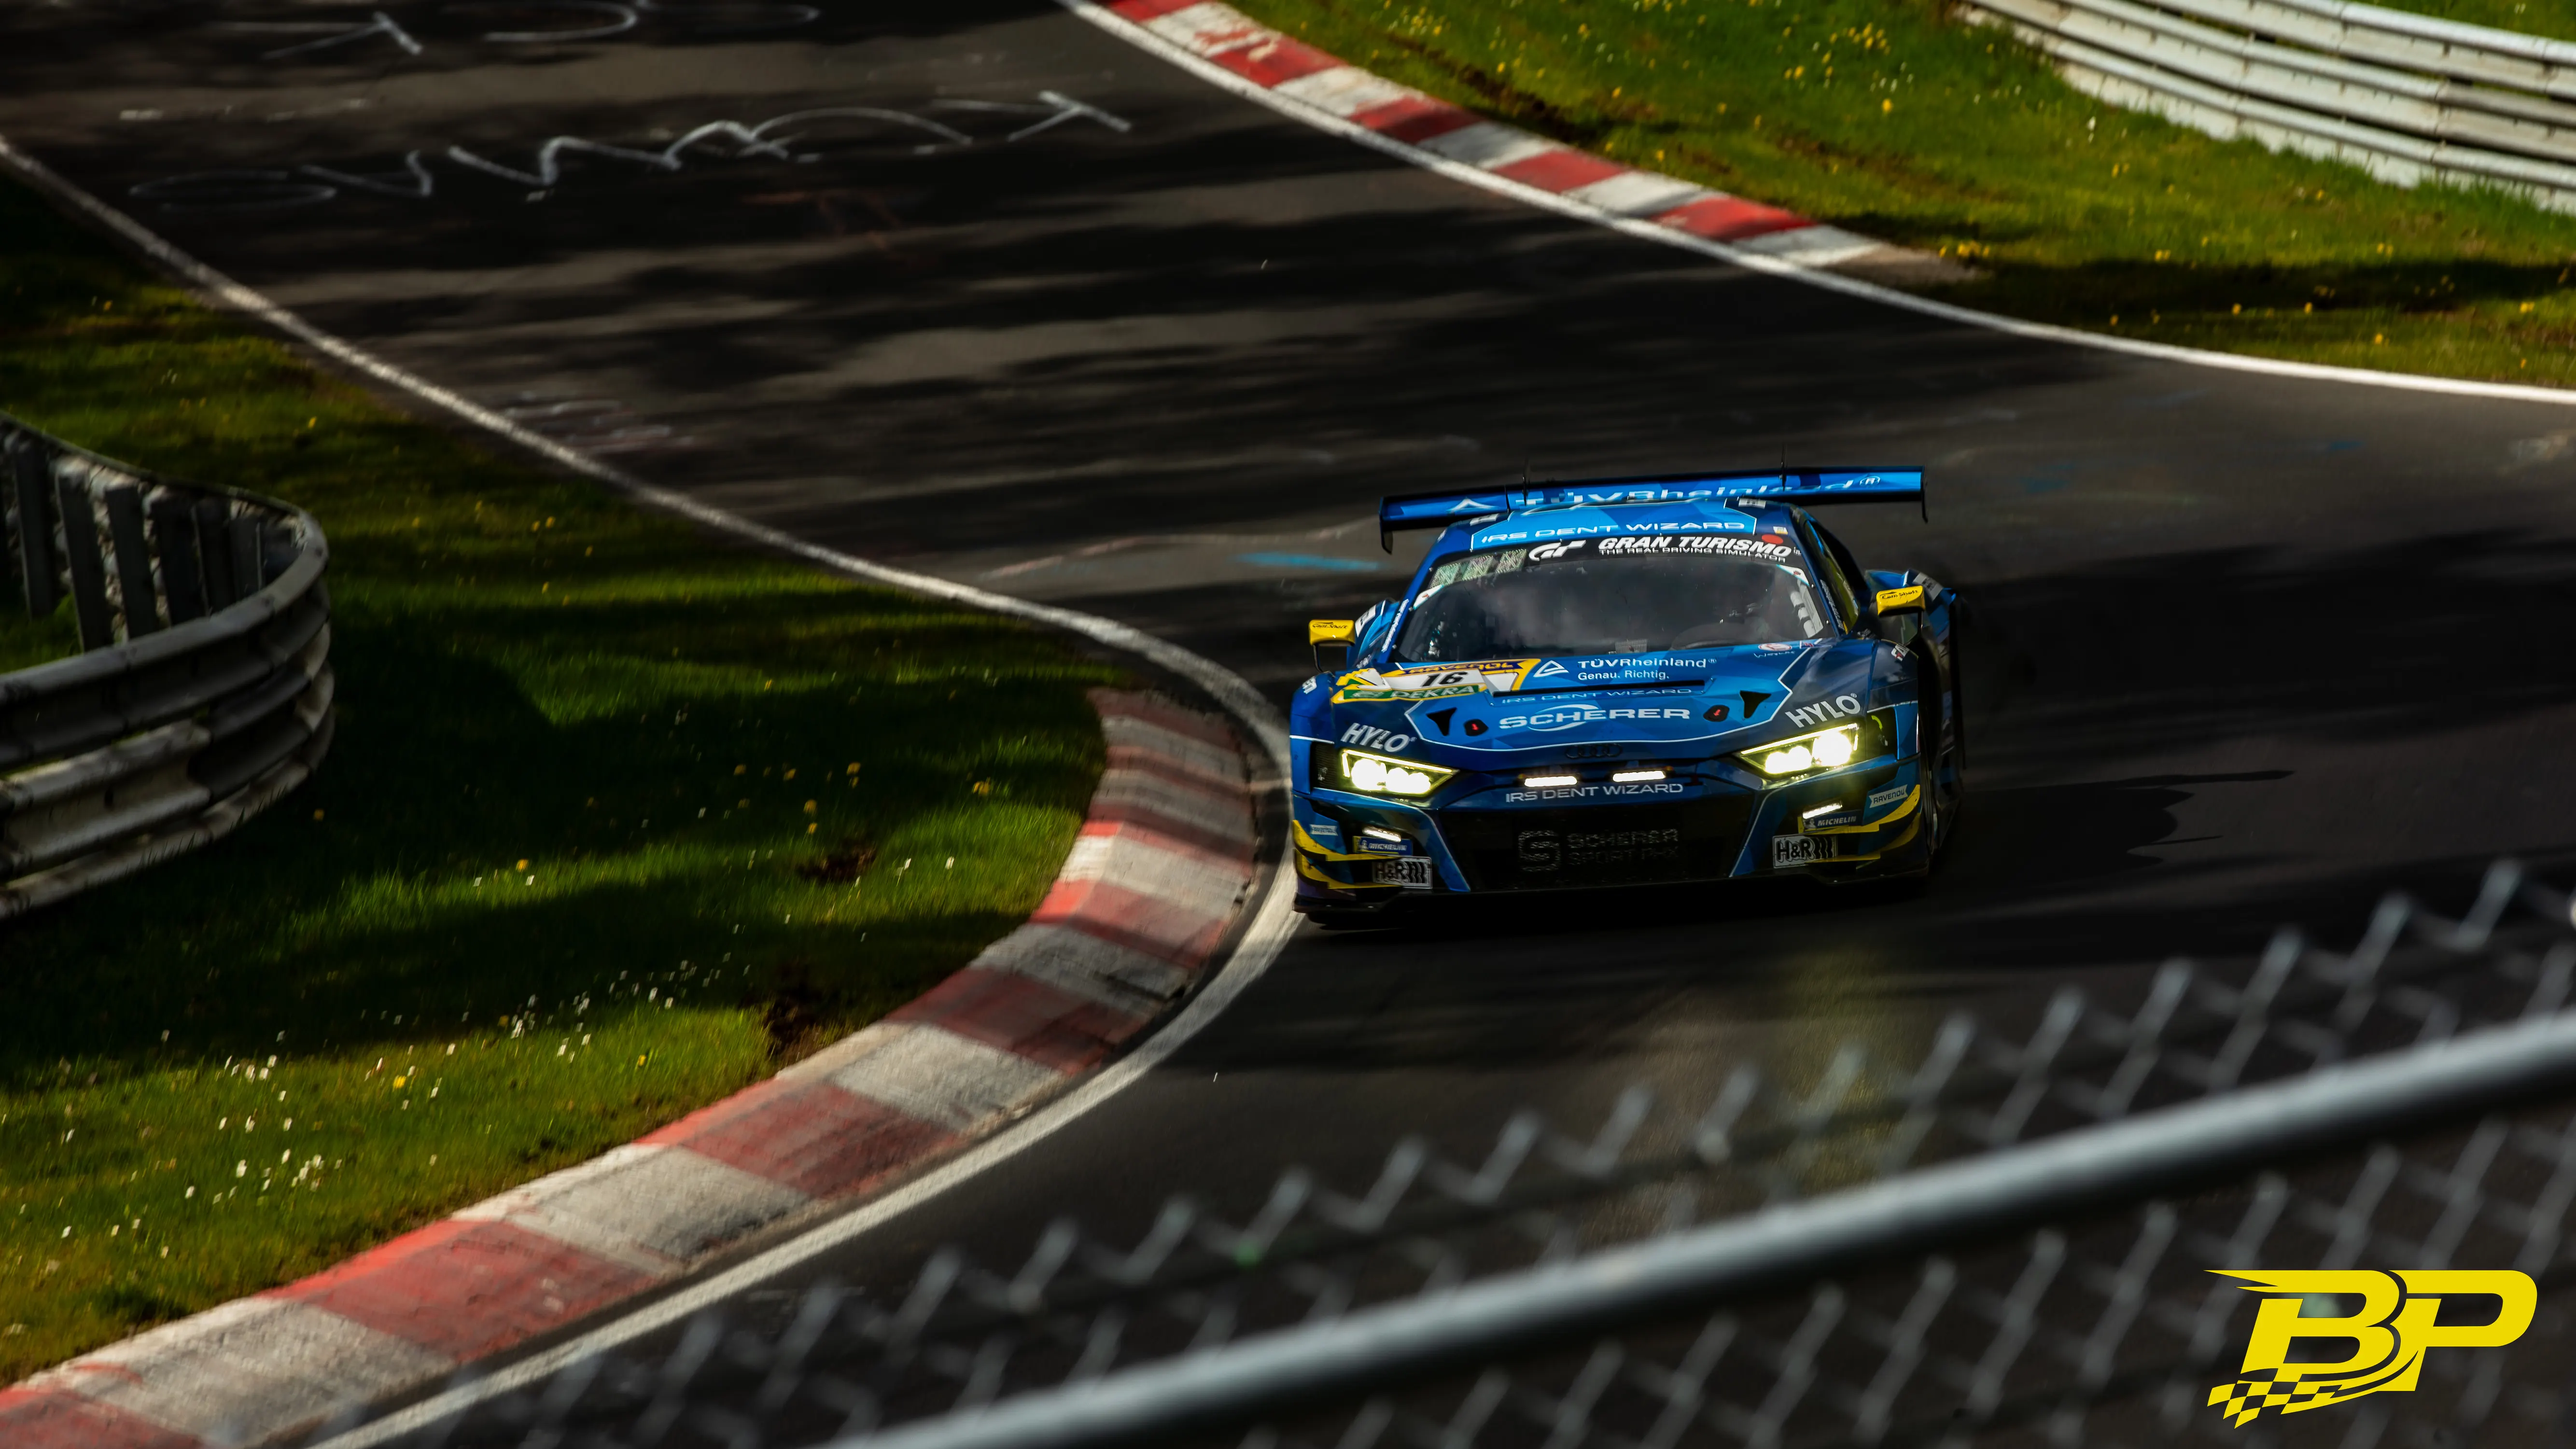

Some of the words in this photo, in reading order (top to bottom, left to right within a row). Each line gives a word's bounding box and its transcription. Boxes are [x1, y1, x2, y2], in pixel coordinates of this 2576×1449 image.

[1482, 532, 1527, 544] IRS
[1535, 524, 1619, 538] DENT
[1626, 522, 1745, 531] WIZARD
[1598, 536, 1673, 550] GRAN
[1680, 536, 1792, 557] TURISMO
[1716, 548, 1786, 563] SIMULATOR
[1409, 662, 1514, 673] RAVENOL
[1578, 672, 1621, 681] Genau.
[1624, 670, 1670, 680] Richtig.
[1420, 671, 1468, 687] 16
[1389, 685, 1476, 699] DEKRA
[1502, 696, 1536, 704] IRS
[1541, 692, 1602, 700] DENT
[1607, 688, 1692, 697] WIZARD
[1498, 708, 1691, 729] SCHERER
[1506, 792, 1538, 803] IRS
[1542, 787, 1599, 800] DENT
[1603, 783, 1684, 794] WIZARD
[1817, 815, 1857, 827] MICHELIN
[1368, 843, 1408, 851] MICHELIN
[1775, 837, 1814, 862] H&R
